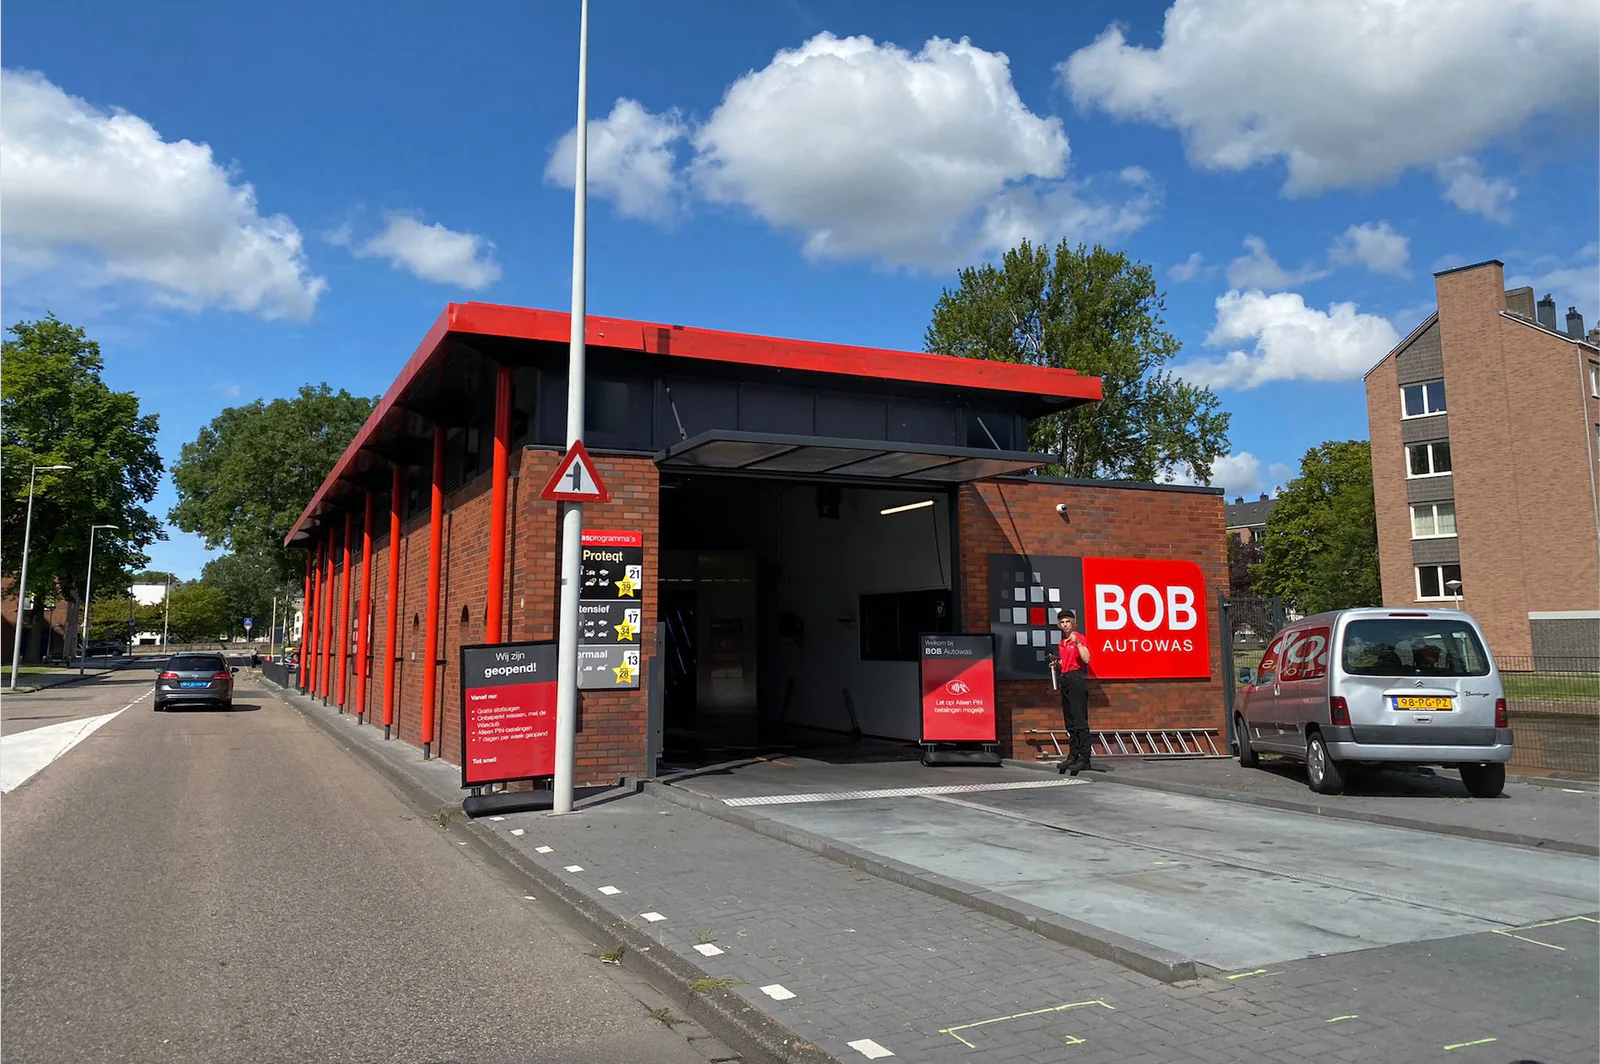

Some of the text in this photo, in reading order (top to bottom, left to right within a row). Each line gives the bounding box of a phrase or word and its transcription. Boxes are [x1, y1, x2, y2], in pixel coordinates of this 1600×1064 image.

[582, 535, 636, 543] asprogramma's
[582, 550, 624, 563] Proteqt
[629, 570, 640, 579] 21
[579, 605, 610, 613] tensief
[1095, 584, 1198, 631] BOB
[628, 614, 638, 623] 17
[1102, 639, 1194, 652] AUTOWAS
[495, 651, 525, 662] Wij zijn
[578, 650, 608, 658] ormaal
[628, 656, 638, 665] 13
[484, 663, 536, 678] geopend!
